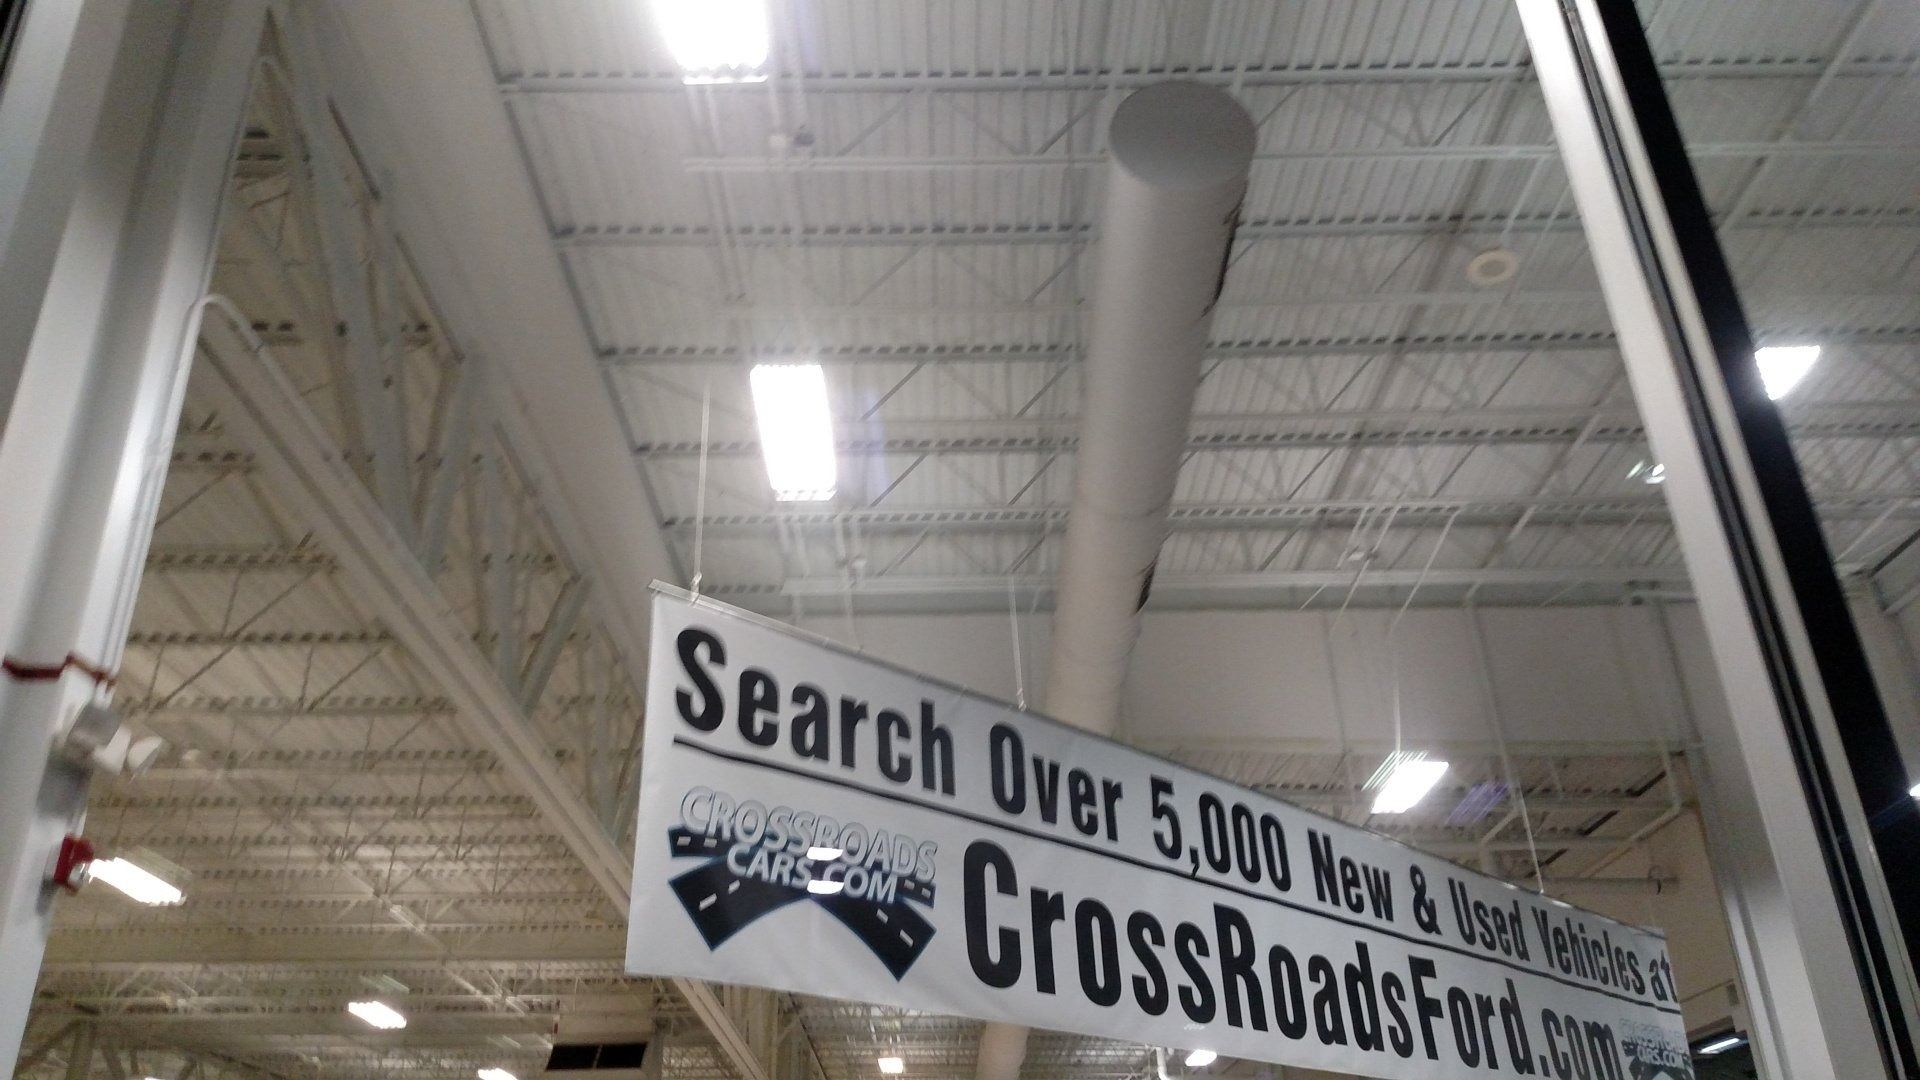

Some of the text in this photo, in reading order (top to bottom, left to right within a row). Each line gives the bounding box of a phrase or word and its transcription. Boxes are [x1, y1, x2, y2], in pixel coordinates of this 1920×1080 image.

[675, 626, 1680, 1004] Search Over 5,000 New & Used Vehicles at
[680, 785, 938, 883] CROSSROADS
[727, 843, 898, 904] CARSCOM
[963, 838, 1624, 1080] CrossRoadsFord.com
